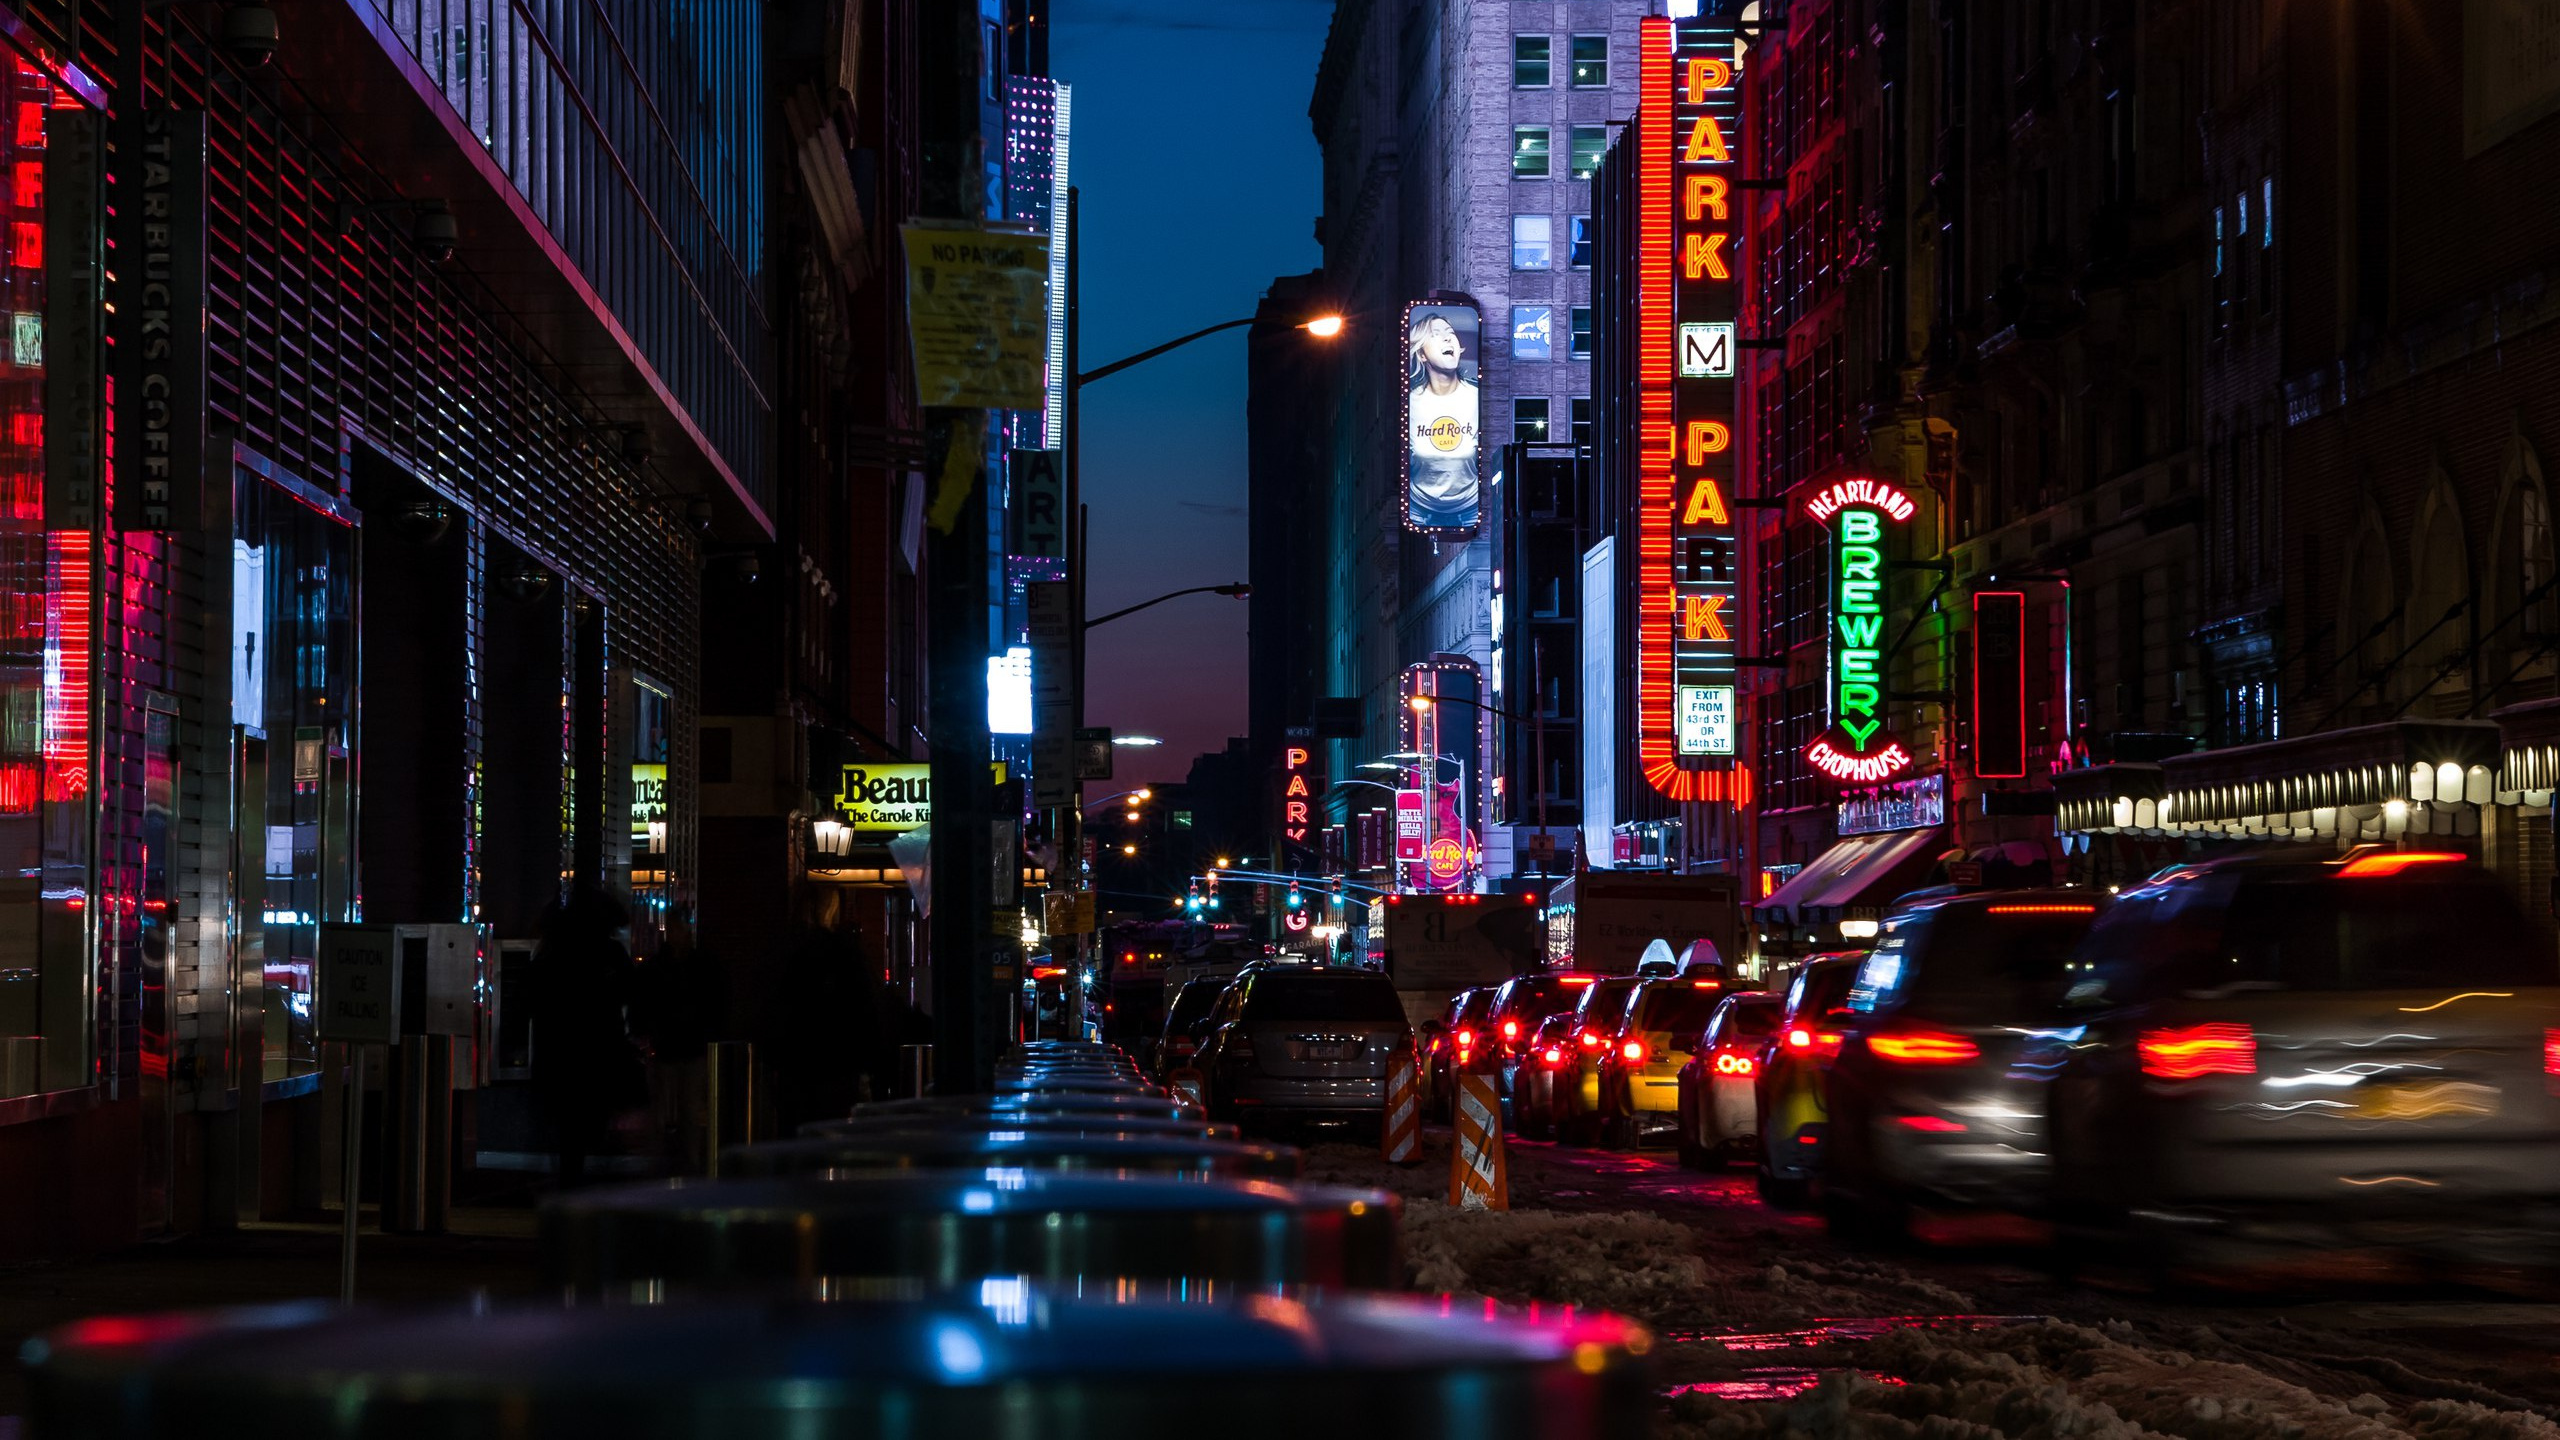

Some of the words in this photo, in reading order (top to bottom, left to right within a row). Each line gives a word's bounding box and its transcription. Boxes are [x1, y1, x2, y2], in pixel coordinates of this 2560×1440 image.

[1685, 58, 1730, 281] PARK
[141, 111, 172, 362] STARBUCKS
[932, 244, 956, 262] NO
[959, 245, 1026, 267] PARKING
[1417, 424, 1445, 437] Hard
[1447, 422, 1473, 437] Rock
[141, 373, 171, 529] COFFEE
[1808, 479, 1914, 521] HEARTLAND
[1684, 421, 1730, 642] PARK
[1837, 510, 1884, 752] BREWERY
[1695, 690, 1720, 700] EXIT
[1692, 702, 1723, 712] FROM
[1686, 714, 1709, 724] 43rd
[1713, 714, 1729, 724] ST.
[1700, 726, 1715, 736] OR
[1686, 738, 1709, 748] 44th
[1713, 738, 1729, 748] ST.
[1808, 743, 1911, 782] CHOPHOUSE
[843, 768, 931, 805] Beau
[870, 808, 912, 823] Carole
[1436, 862, 1453, 870] CAFE
[1287, 939, 1325, 952] GARAGE
[337, 948, 383, 966] CAUTION
[351, 975, 368, 992] ICE
[338, 1001, 380, 1019] FALLING
